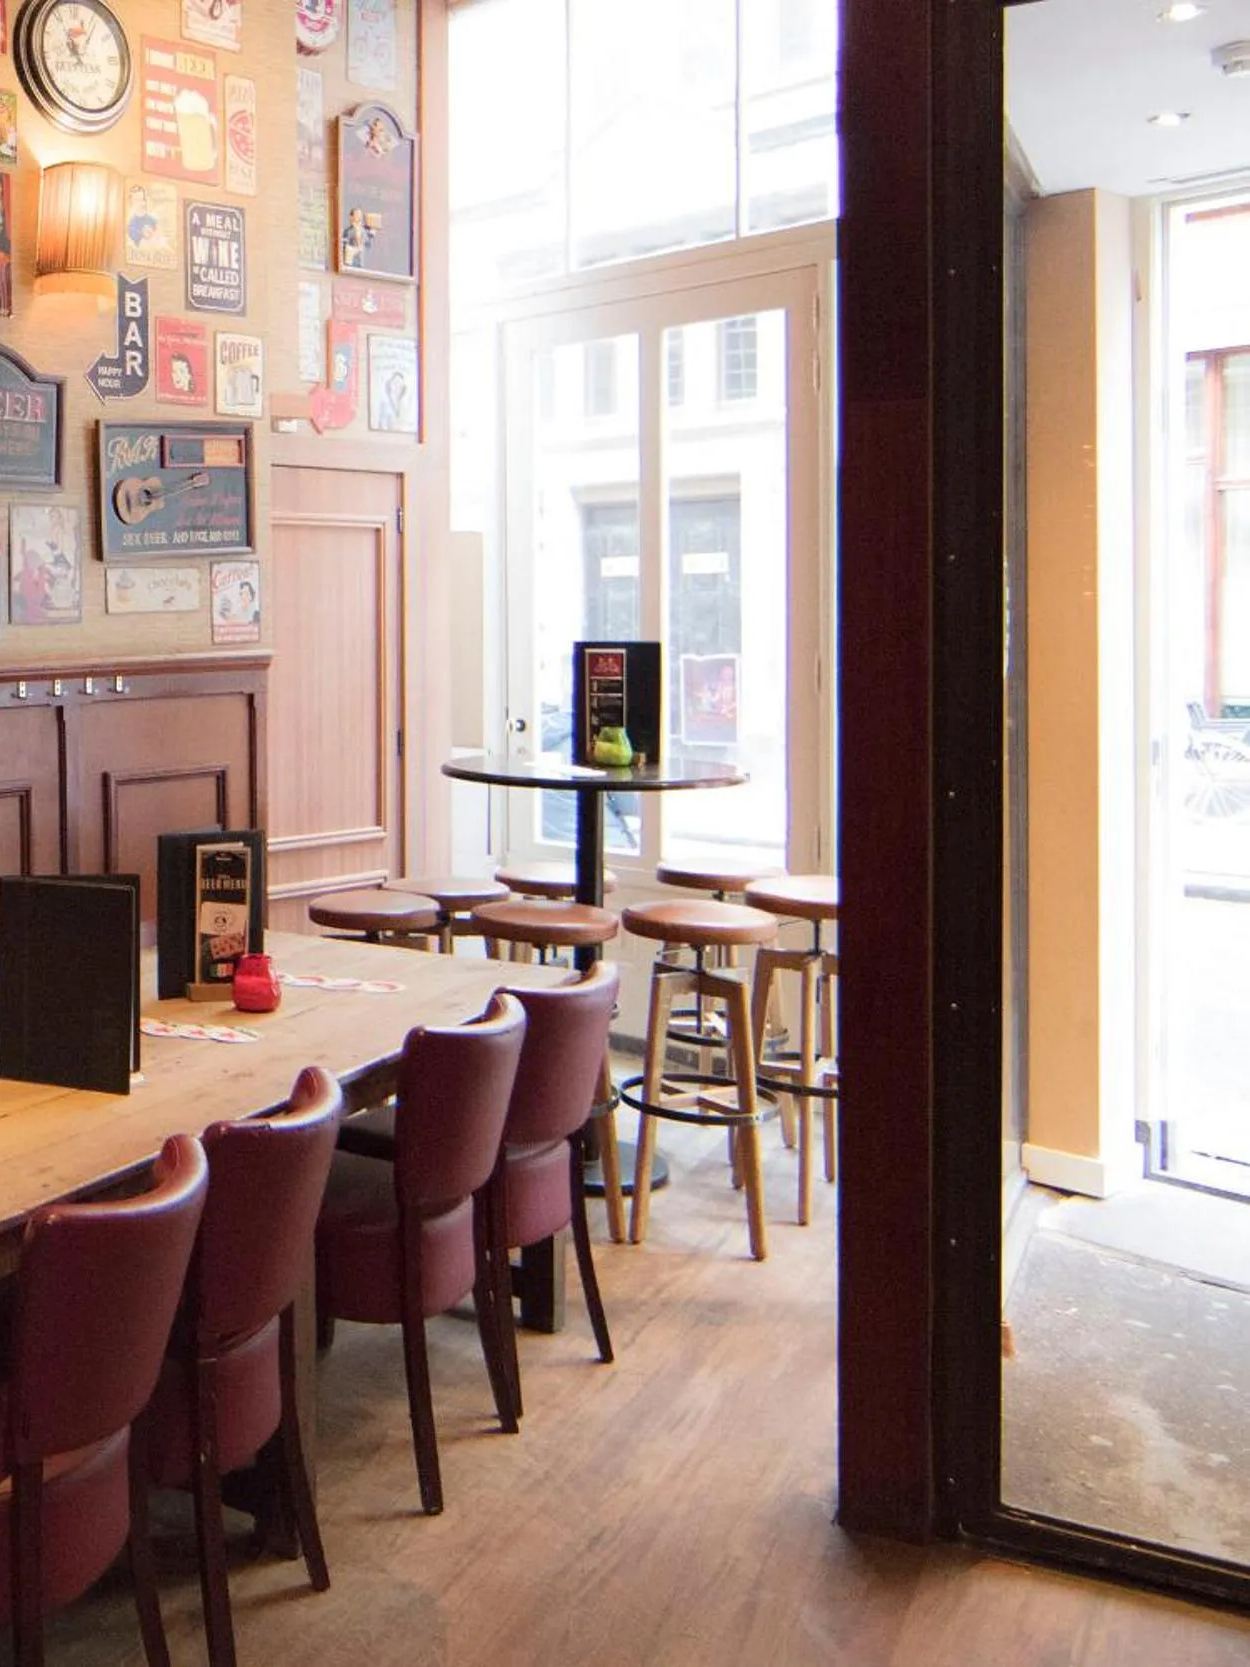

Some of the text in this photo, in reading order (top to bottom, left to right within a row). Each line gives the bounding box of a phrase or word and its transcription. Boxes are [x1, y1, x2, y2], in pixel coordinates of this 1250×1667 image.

[191, 212, 239, 231] A MEAL
[192, 235, 240, 269] WINE
[200, 267, 240, 286] CALLED
[192, 284, 240, 301] BREAKFAST
[124, 291, 144, 377] BAR
[221, 341, 260, 365] COFFEE
[97, 365, 122, 378] HAPPY
[98, 378, 121, 389] HOUR
